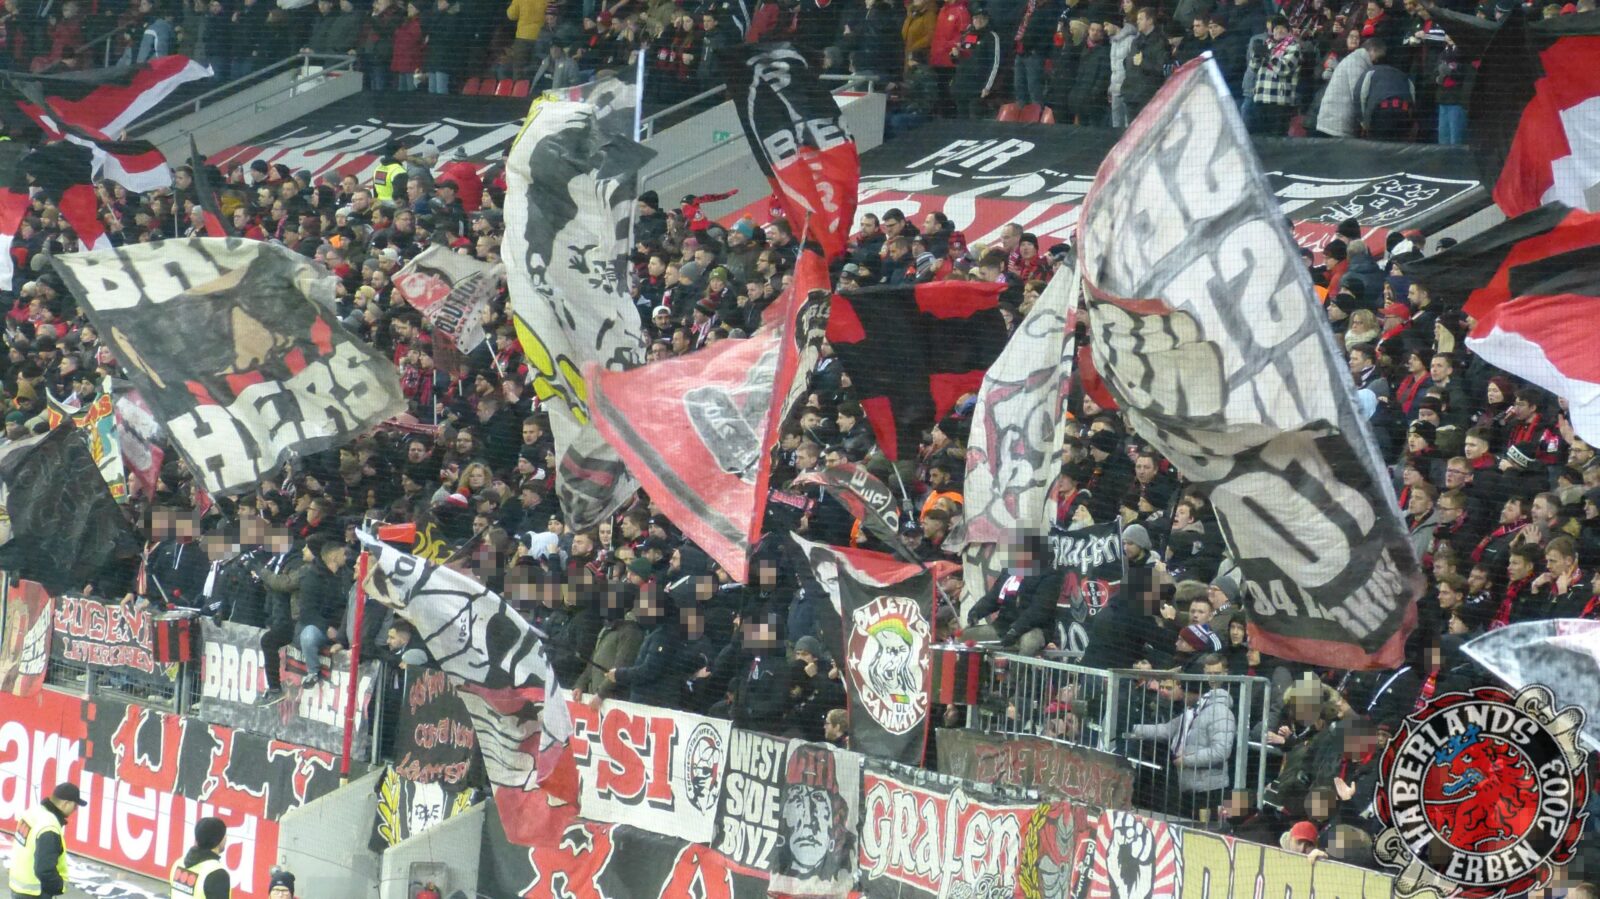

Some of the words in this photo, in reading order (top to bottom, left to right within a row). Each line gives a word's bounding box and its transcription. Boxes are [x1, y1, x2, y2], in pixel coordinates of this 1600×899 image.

[168, 341, 390, 493] HERS
[730, 729, 786, 784] WEST
[725, 772, 780, 829] SIDE
[718, 815, 778, 870] BOYZ
